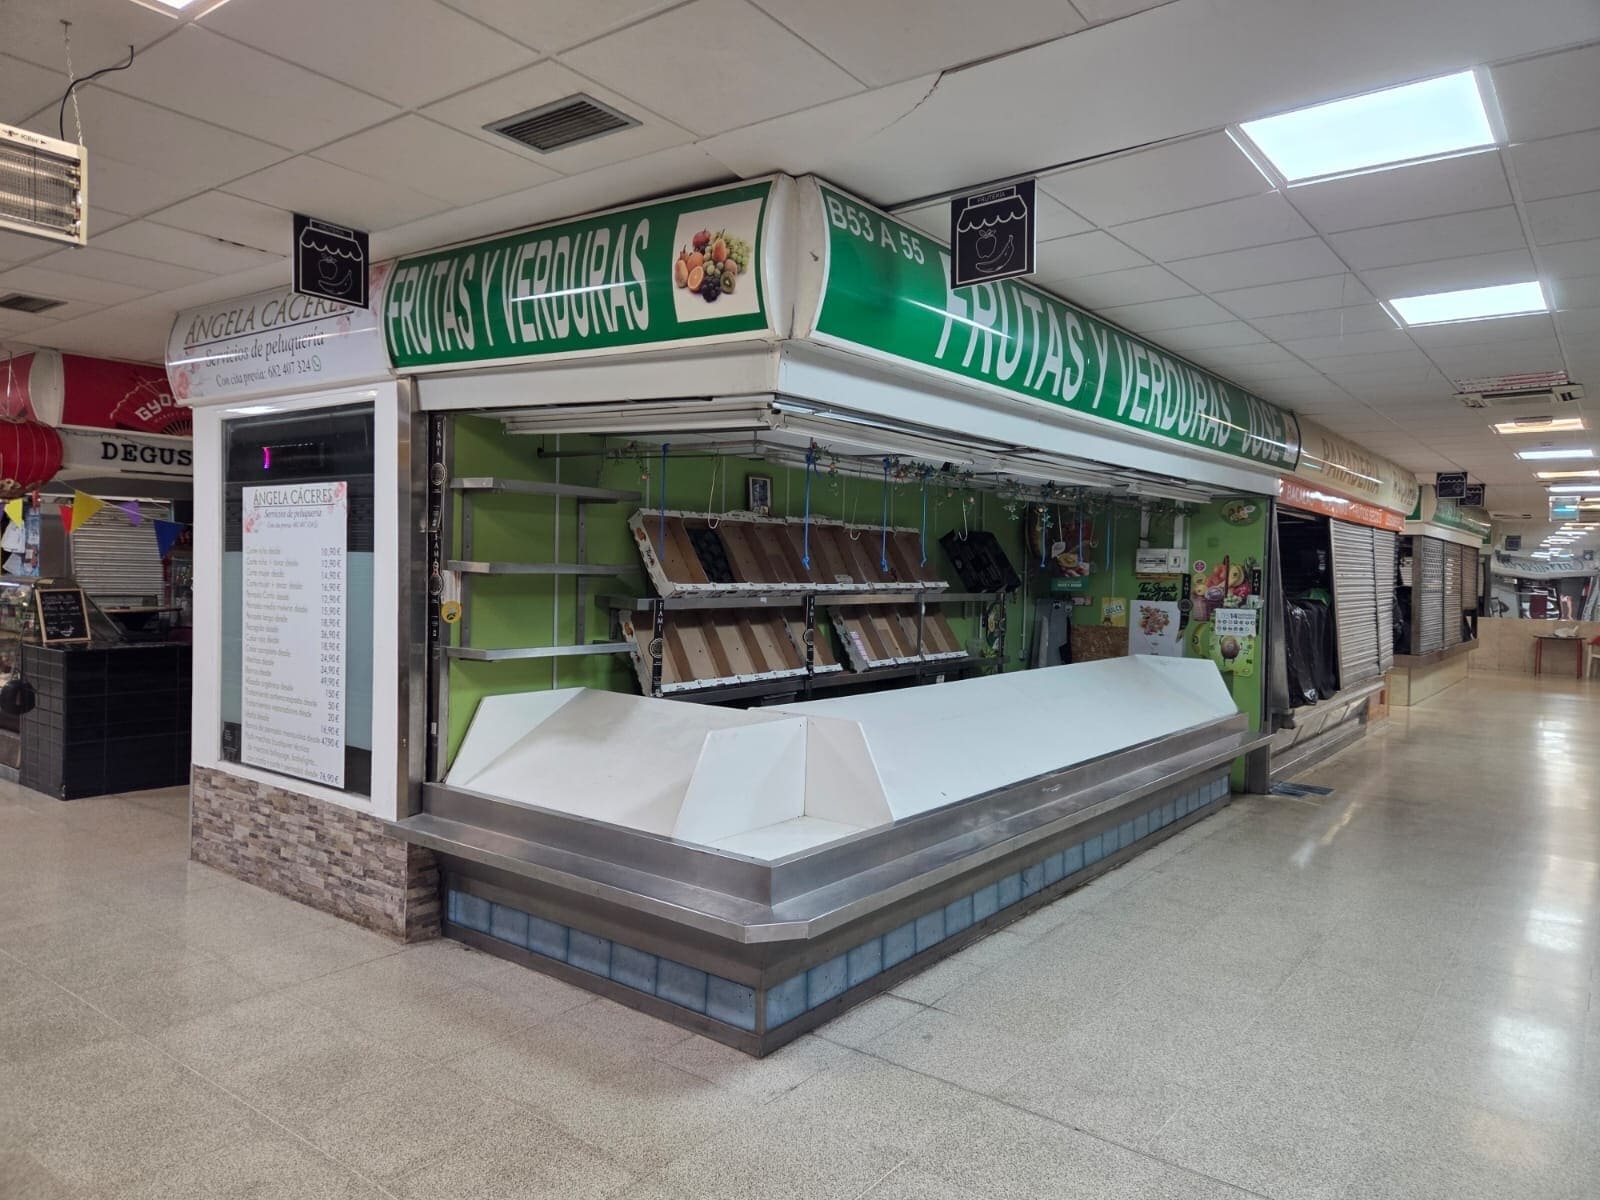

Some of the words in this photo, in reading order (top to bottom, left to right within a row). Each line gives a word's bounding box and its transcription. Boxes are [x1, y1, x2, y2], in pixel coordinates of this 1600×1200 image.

[826, 195, 874, 242] B53
[880, 221, 898, 253] A
[900, 231, 925, 264] 55
[386, 254, 475, 358] FRUTAS
[480, 249, 501, 347] Y
[501, 218, 650, 344] VERDURAS
[184, 303, 255, 345] ÁNGELA
[205, 344, 248, 368] Servicios
[250, 338, 263, 359] de
[265, 327, 324, 362] peluquería
[935, 251, 1085, 401] FRUTAS
[1090, 321, 1109, 409] Y
[1116, 334, 1233, 447] VERDURAS
[1242, 394, 1280, 461] JOSE
[216, 374, 230, 388] Con
[230, 372, 242, 385] cita
[268, 366, 282, 378] 682
[282, 362, 295, 375] 407
[298, 359, 311, 372] 324
[134, 393, 176, 421] GYO
[253, 489, 288, 505] ÁNGELA
[290, 488, 333, 504] CÁCERES
